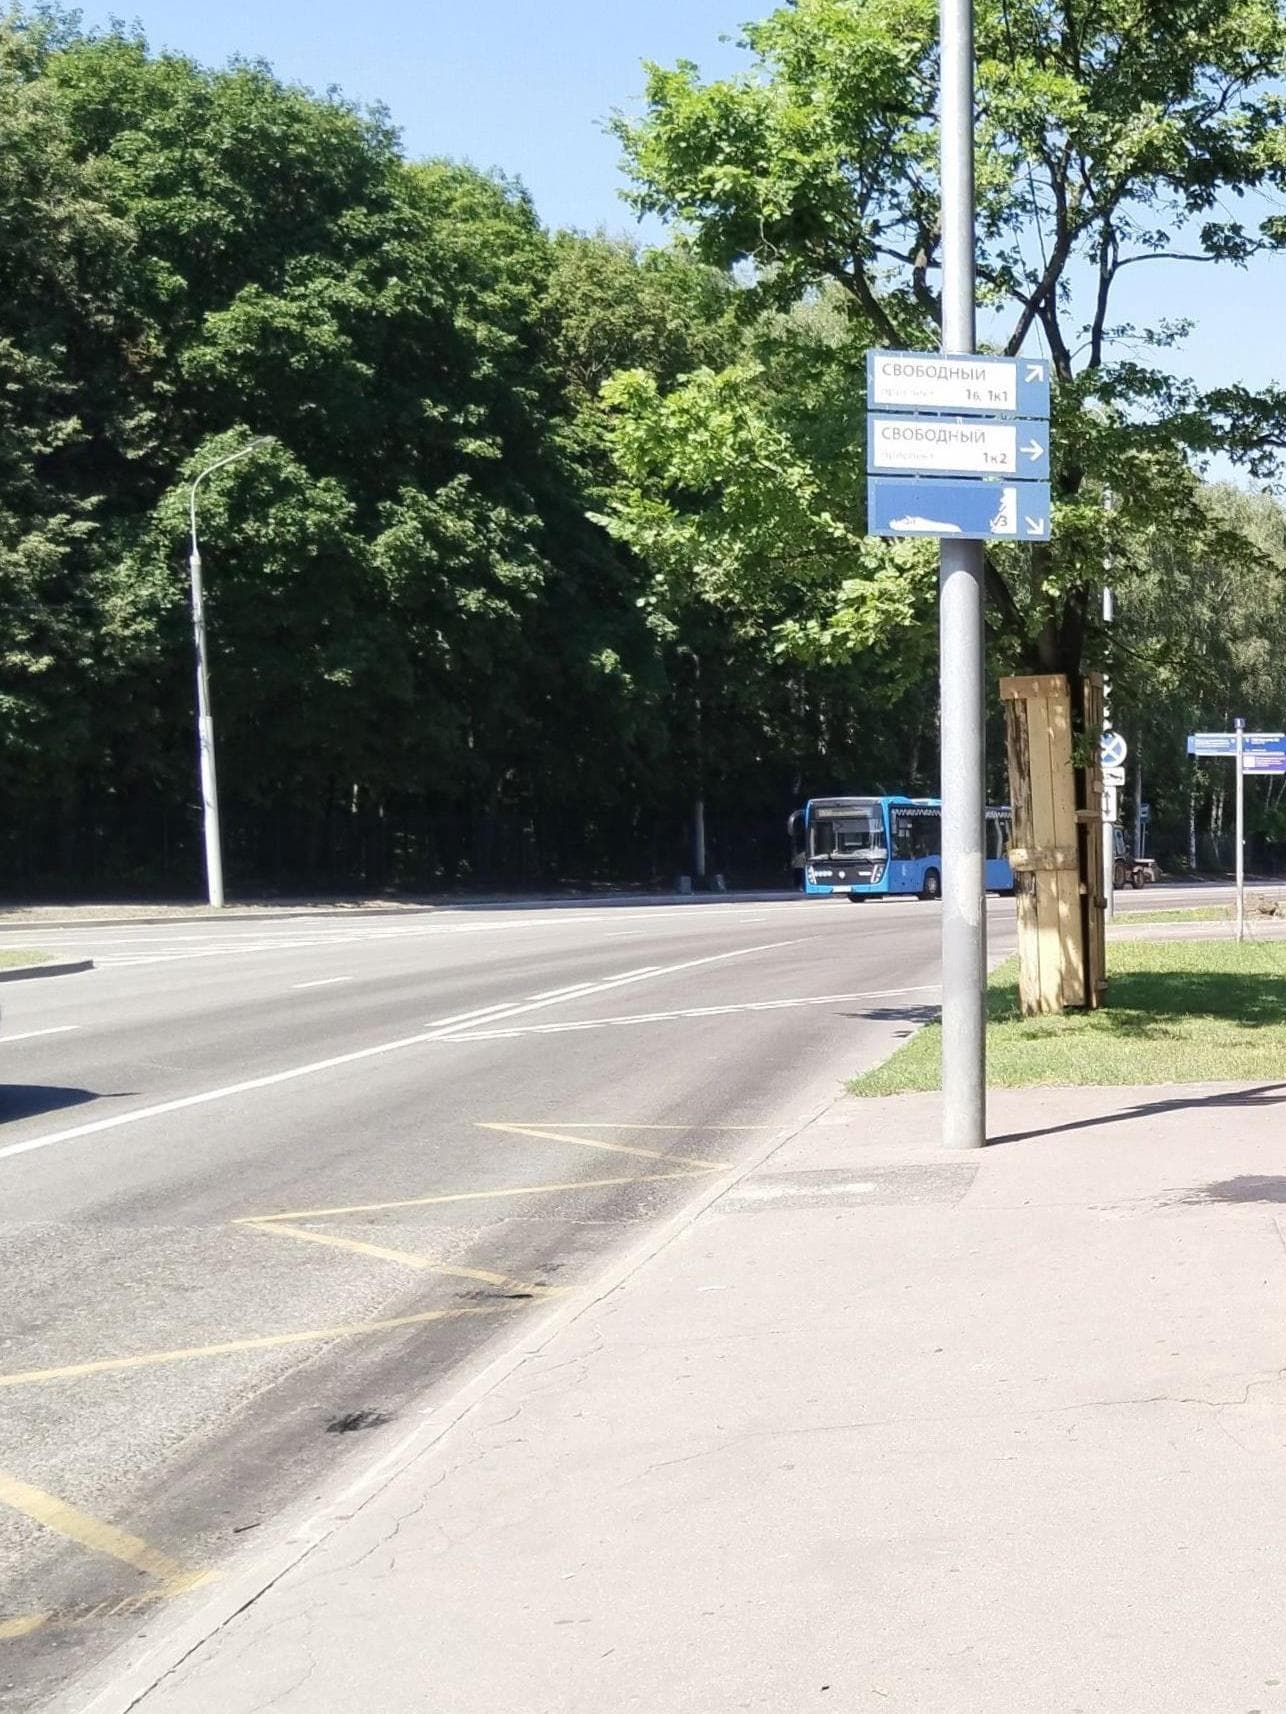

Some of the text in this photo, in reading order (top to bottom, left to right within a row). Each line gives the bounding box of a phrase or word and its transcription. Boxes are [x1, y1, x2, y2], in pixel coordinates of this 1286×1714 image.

[881, 363, 987, 381] СВОБОДНЫЙ
[881, 426, 986, 444] СВОБОДНЫЙ
[982, 452, 1008, 465] 1к2
